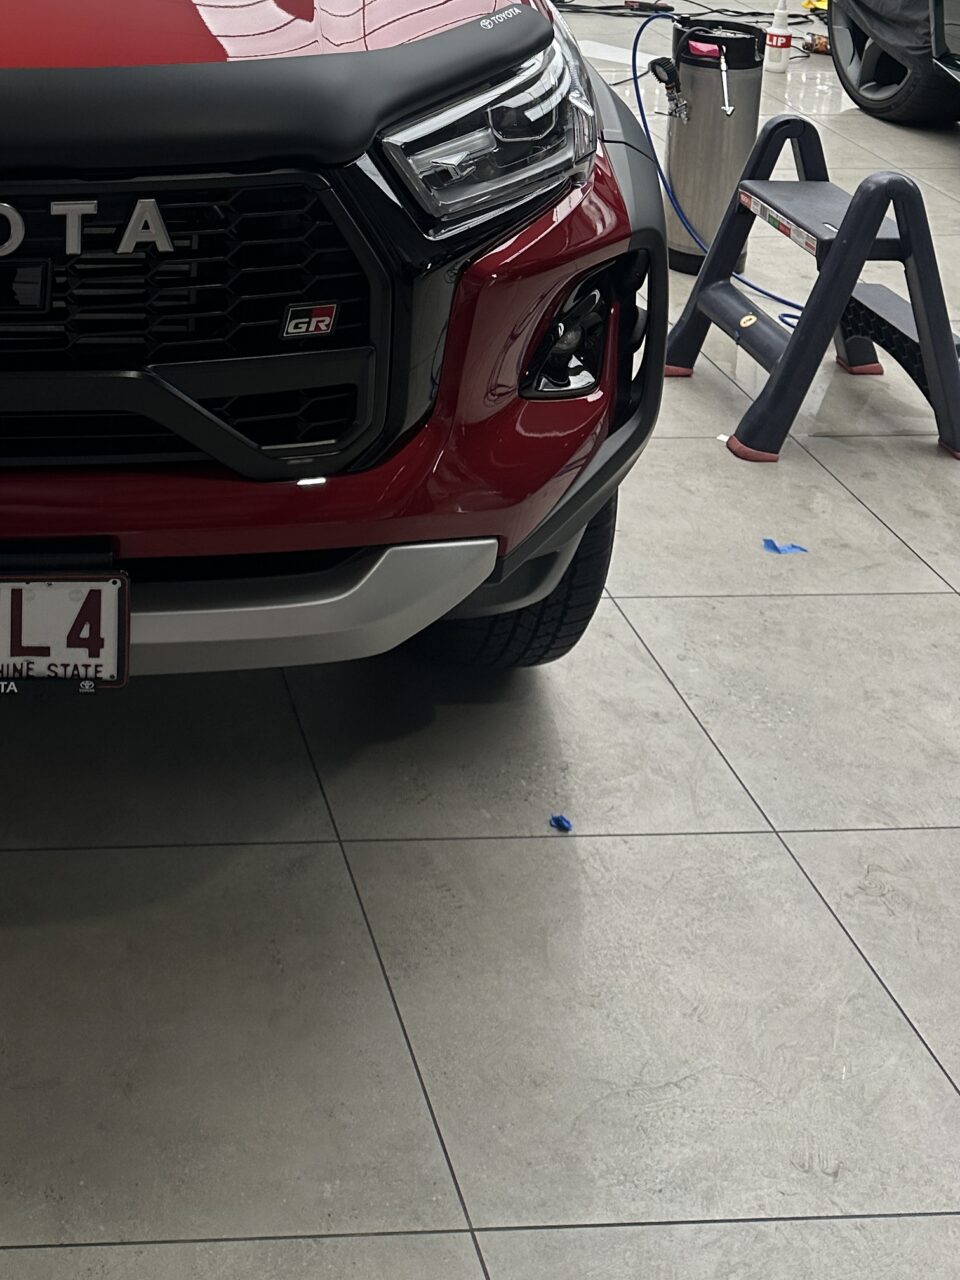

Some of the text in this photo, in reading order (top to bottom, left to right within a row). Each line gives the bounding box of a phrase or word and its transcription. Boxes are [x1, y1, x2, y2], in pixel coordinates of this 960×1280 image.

[491, 7, 522, 24] TOYOTA
[287, 316, 331, 334] GR
[47, 663, 104, 680] STATE
